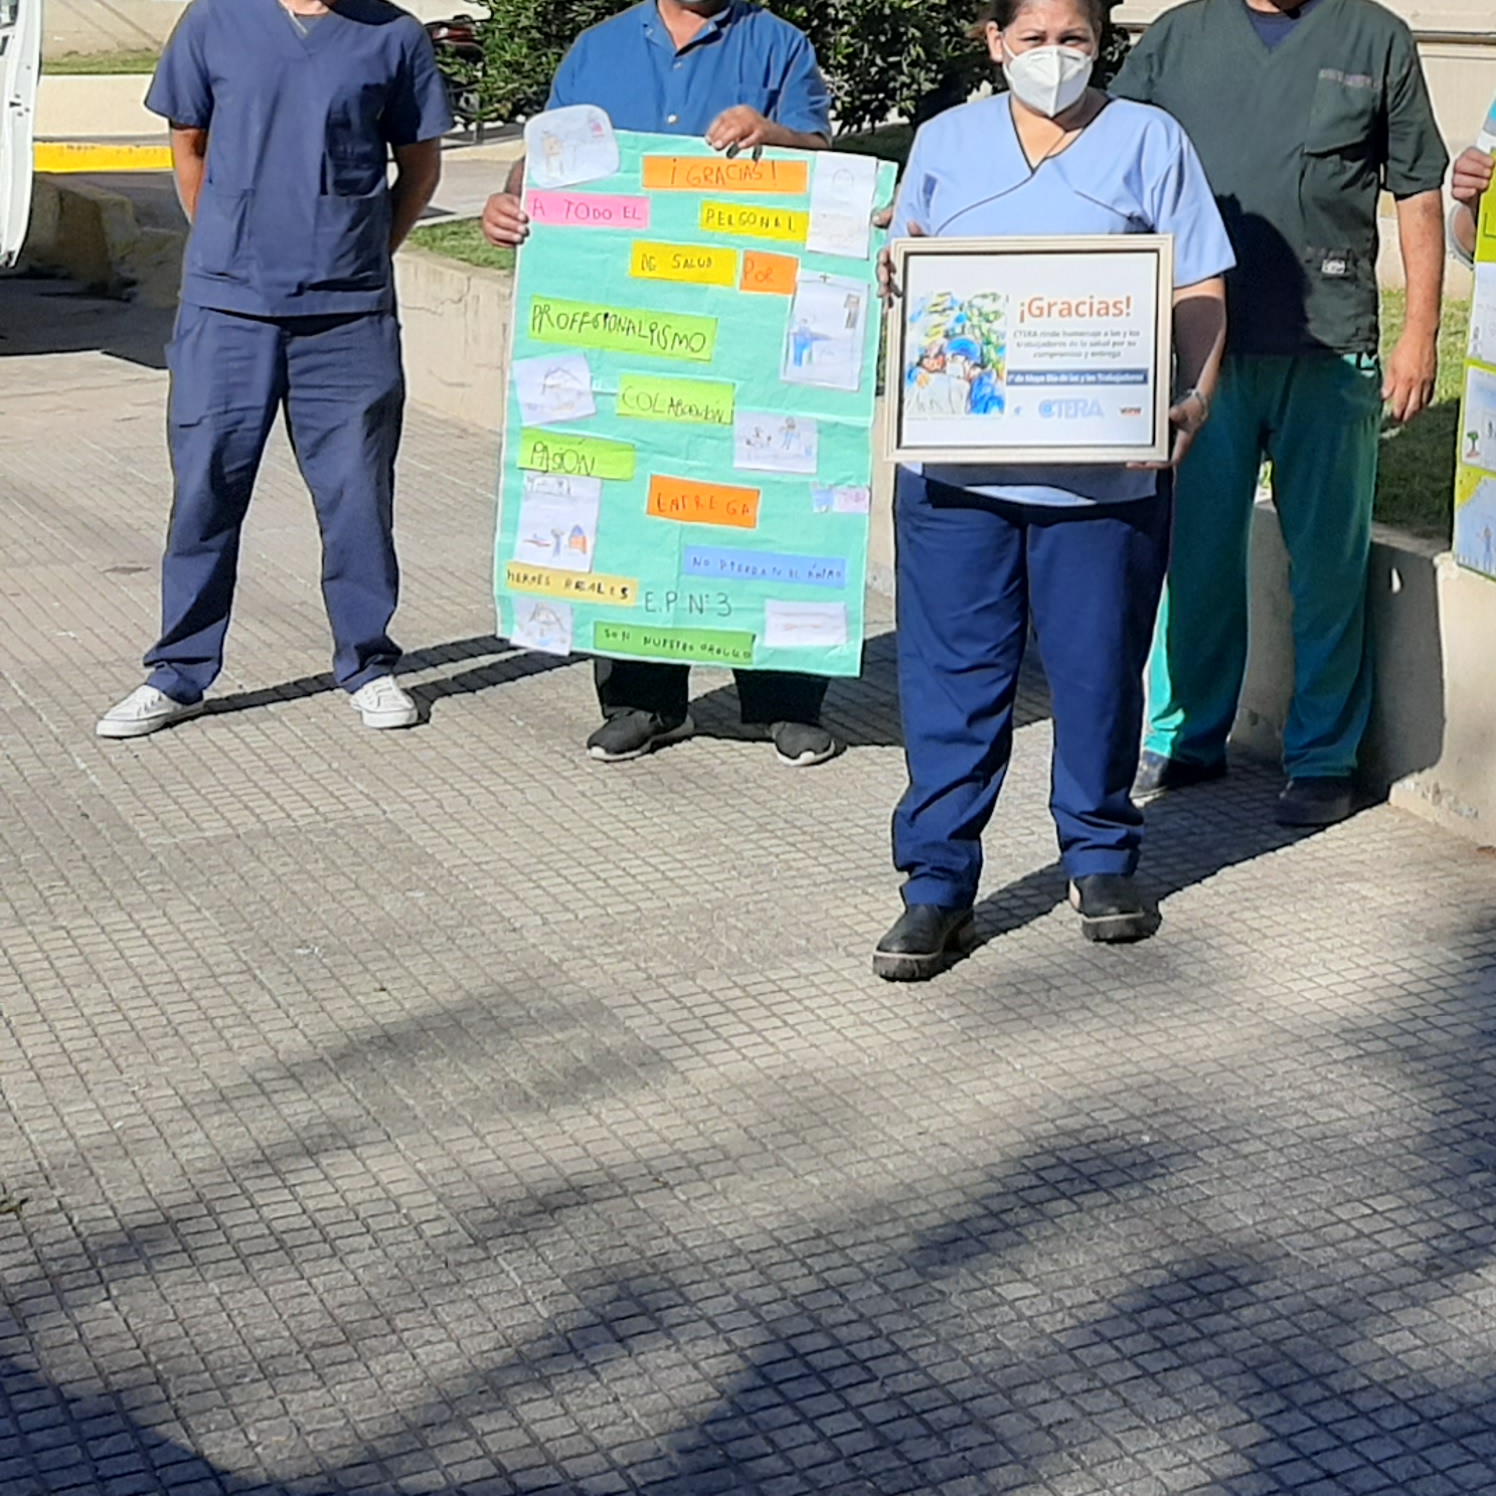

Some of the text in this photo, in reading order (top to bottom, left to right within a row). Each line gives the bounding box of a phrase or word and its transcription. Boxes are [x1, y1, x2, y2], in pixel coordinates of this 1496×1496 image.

[532, 197, 642, 221] A TODO EL
[672, 253, 713, 270] SALUD
[744, 258, 774, 283] POR
[1019, 294, 1132, 323] ¡Gracias!
